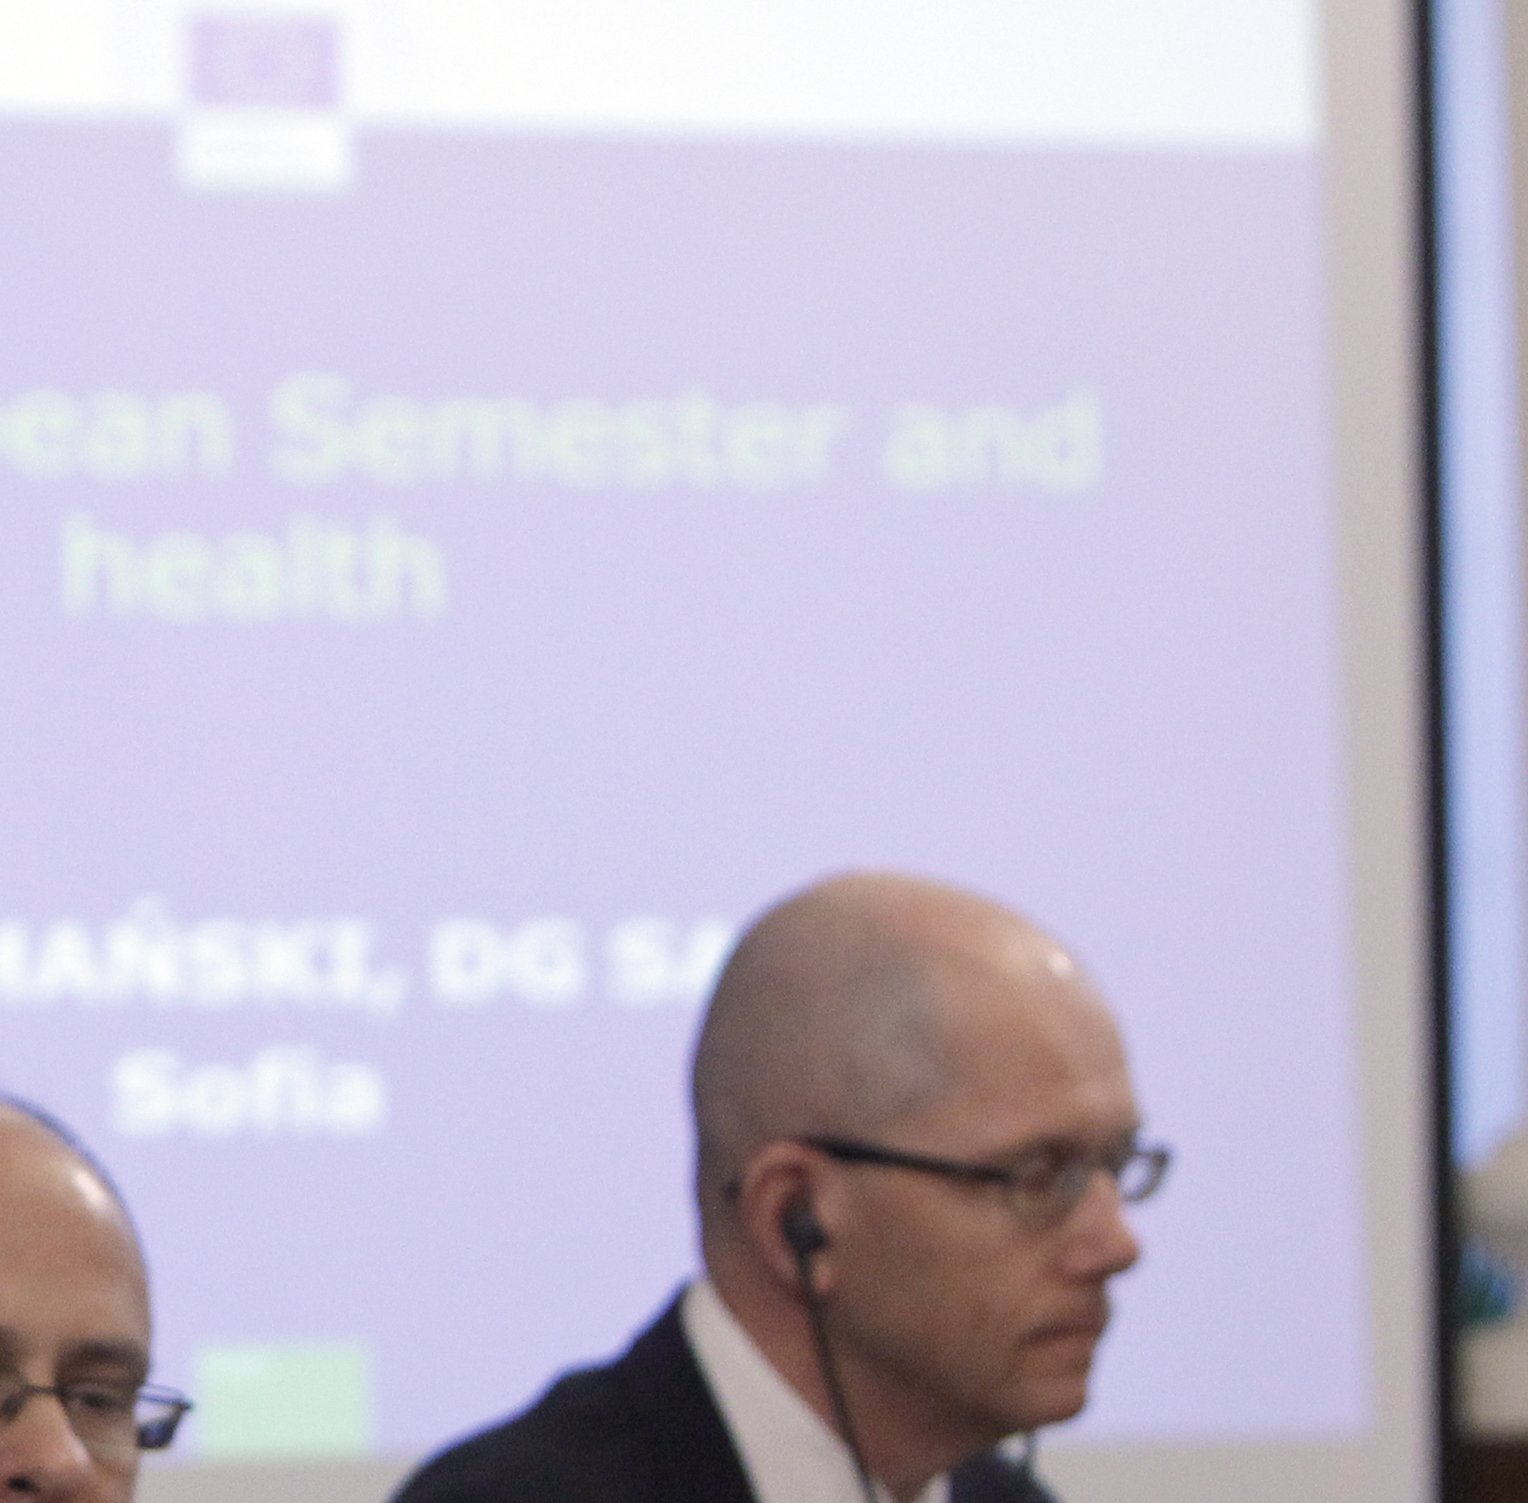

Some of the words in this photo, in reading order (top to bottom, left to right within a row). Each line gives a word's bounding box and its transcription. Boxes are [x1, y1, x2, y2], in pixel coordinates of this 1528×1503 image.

[267, 371, 846, 488] Semester
[881, 390, 1104, 491] and
[58, 512, 449, 623] health
[429, 917, 588, 1004] DG
[110, 1046, 388, 1137] Sofia
